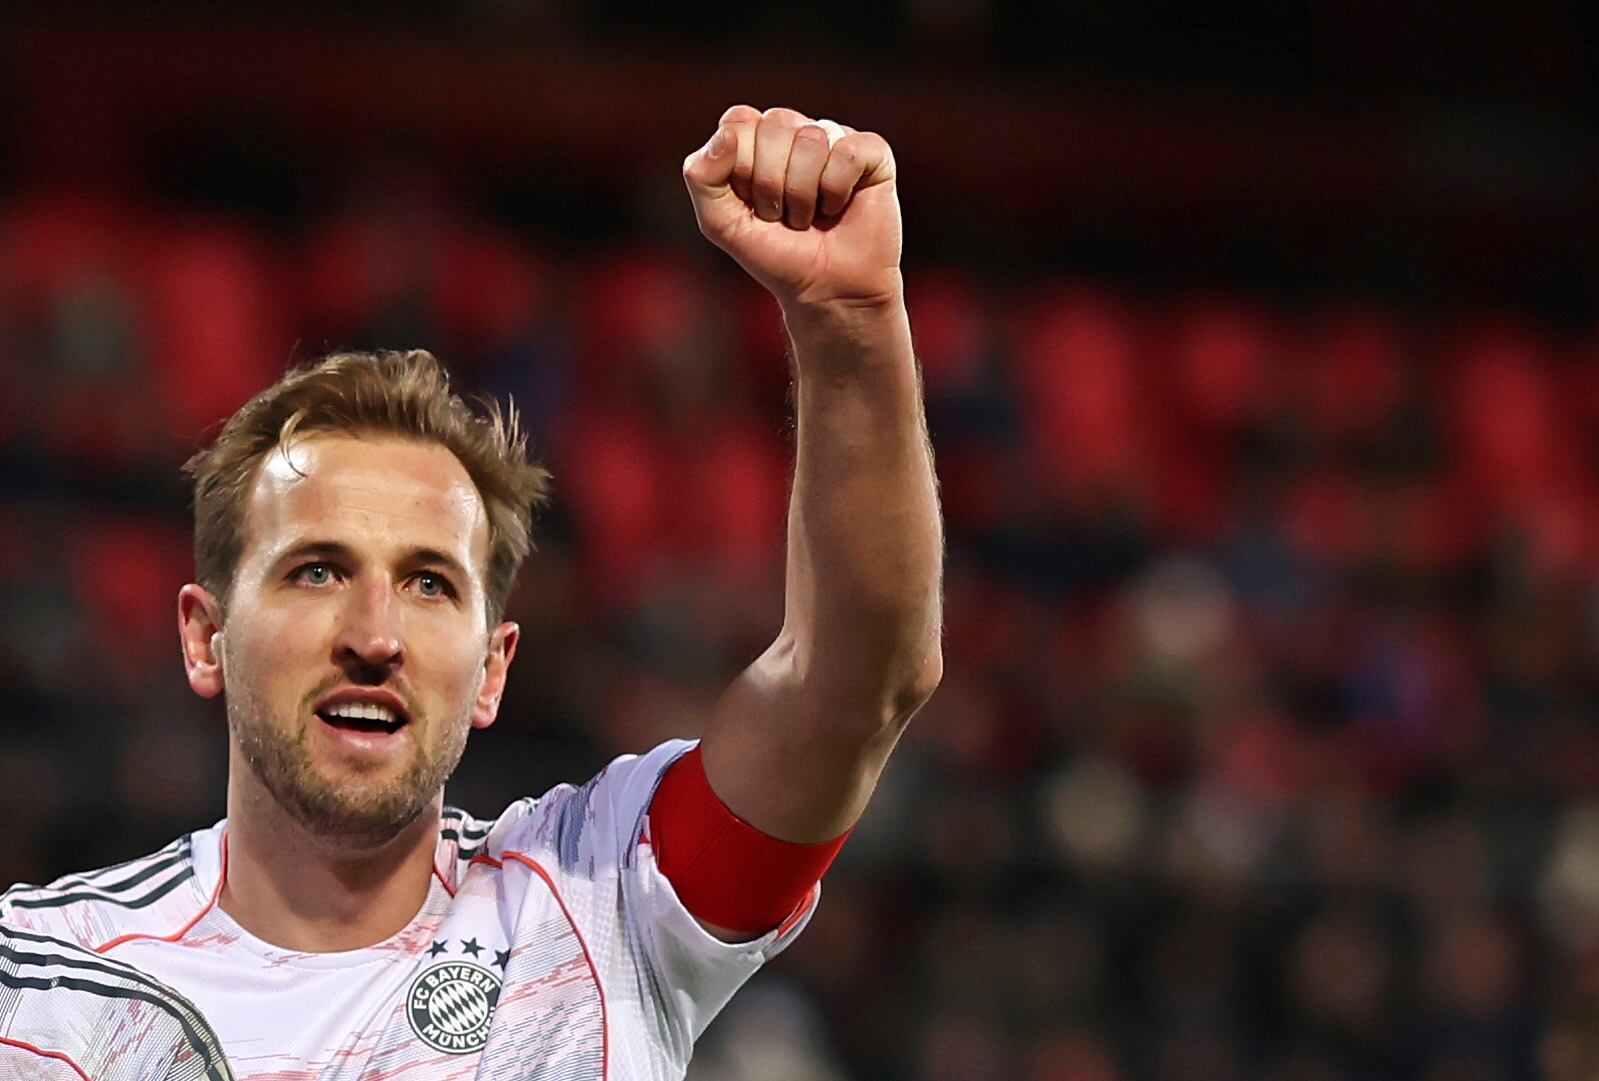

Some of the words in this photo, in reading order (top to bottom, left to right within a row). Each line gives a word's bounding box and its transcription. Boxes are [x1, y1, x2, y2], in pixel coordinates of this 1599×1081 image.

[413, 987, 430, 1010] FC
[425, 966, 496, 993] BAYERN
[421, 1006, 496, 1048] MÜNCH
